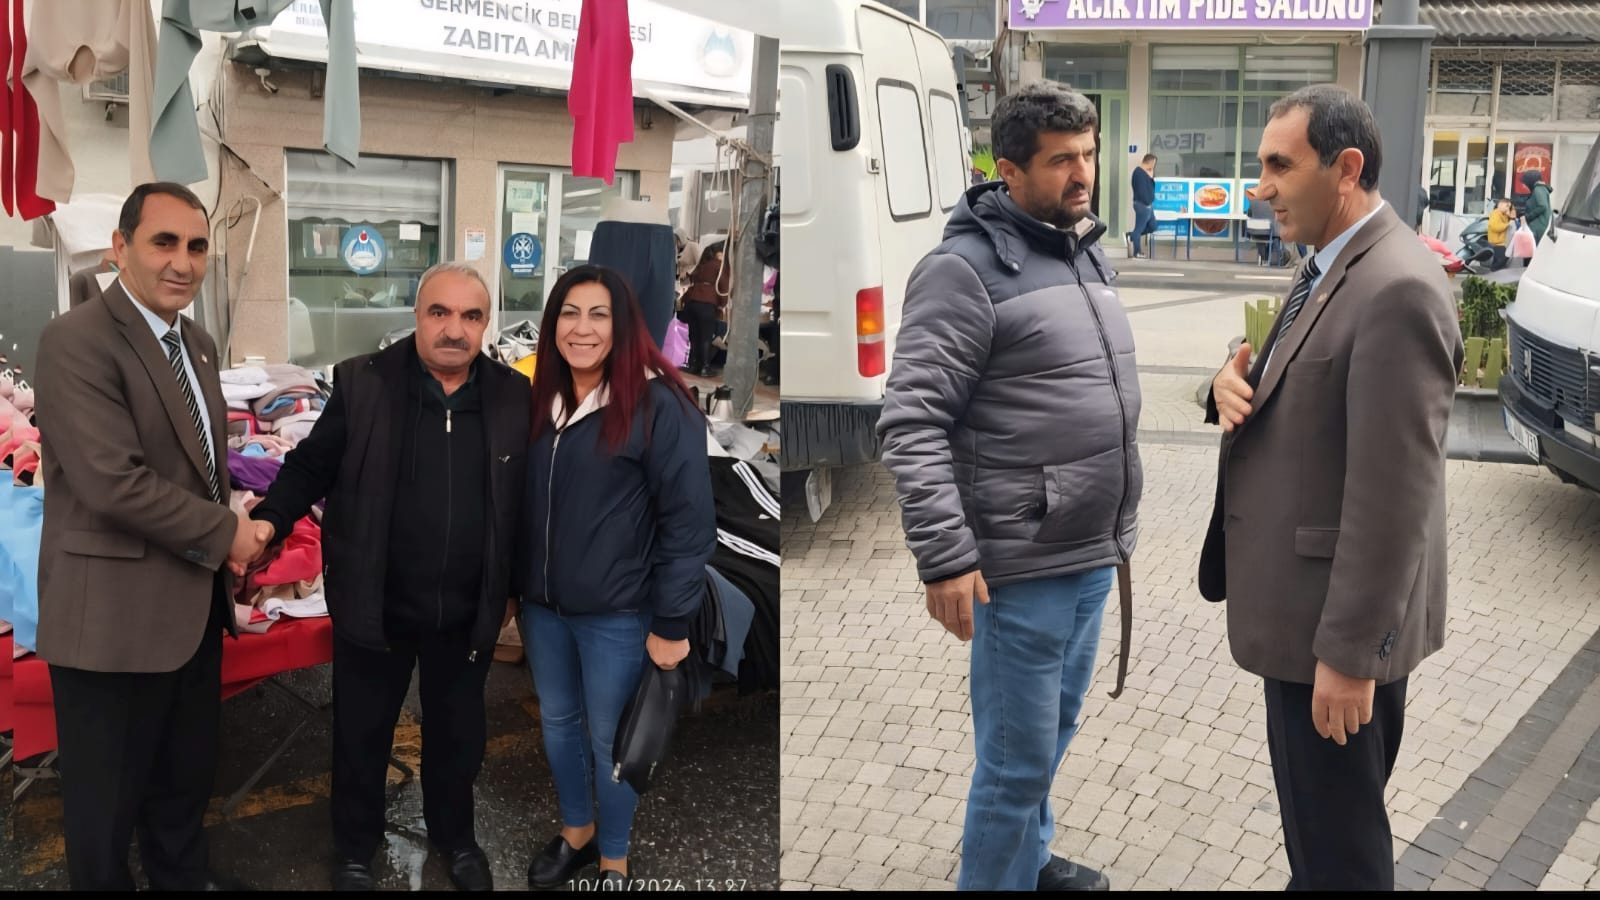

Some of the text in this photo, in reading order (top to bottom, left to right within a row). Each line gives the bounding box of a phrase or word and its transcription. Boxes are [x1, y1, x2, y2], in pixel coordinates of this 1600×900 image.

[1188, 0, 1248, 19] PIDE
[1254, 0, 1365, 19] SALONU
[443, 26, 529, 56] ZABITA
